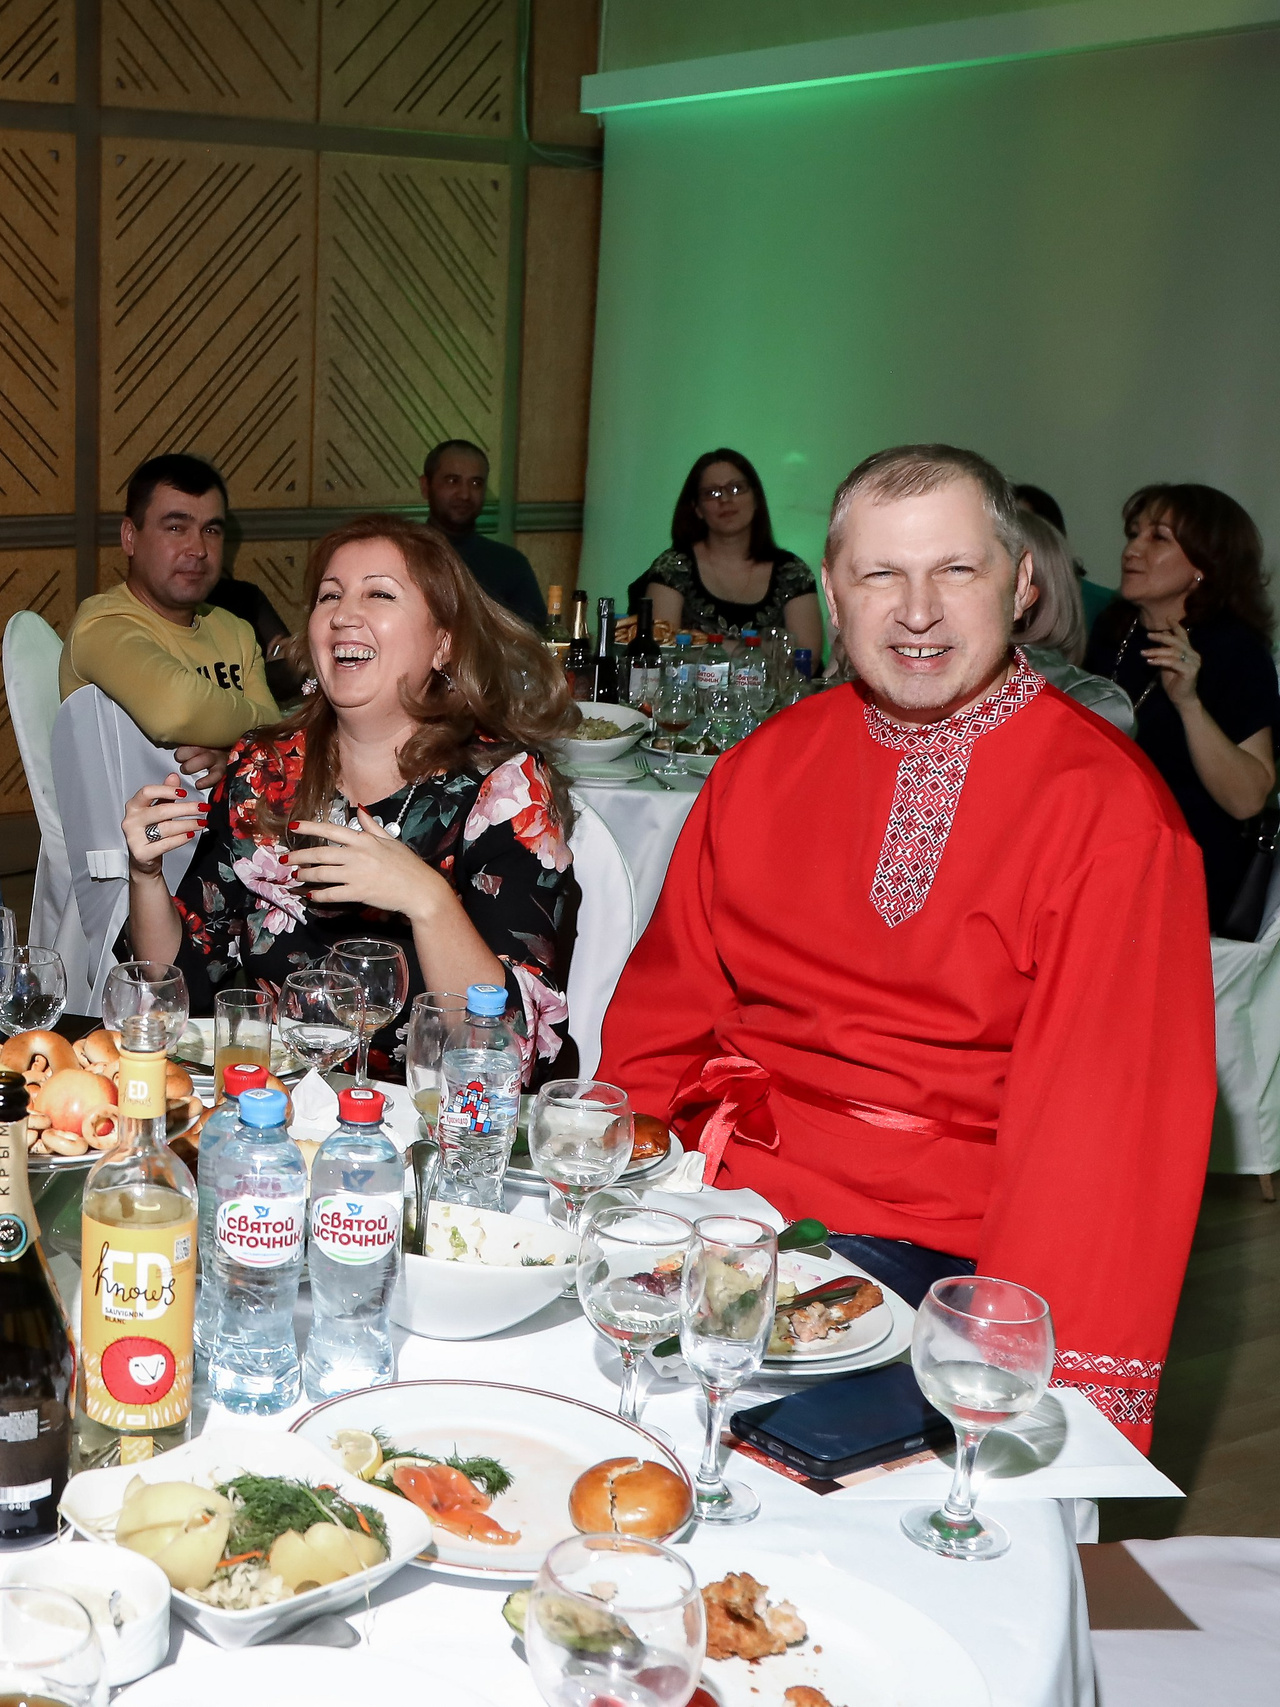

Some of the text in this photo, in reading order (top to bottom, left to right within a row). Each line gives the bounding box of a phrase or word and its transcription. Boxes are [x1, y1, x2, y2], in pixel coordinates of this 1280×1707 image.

[128, 1079, 149, 1100] ED
[102, 1249, 173, 1321] ED
[104, 1307, 144, 1318] SAUVIGNON
[104, 1315, 126, 1325] BLANC
